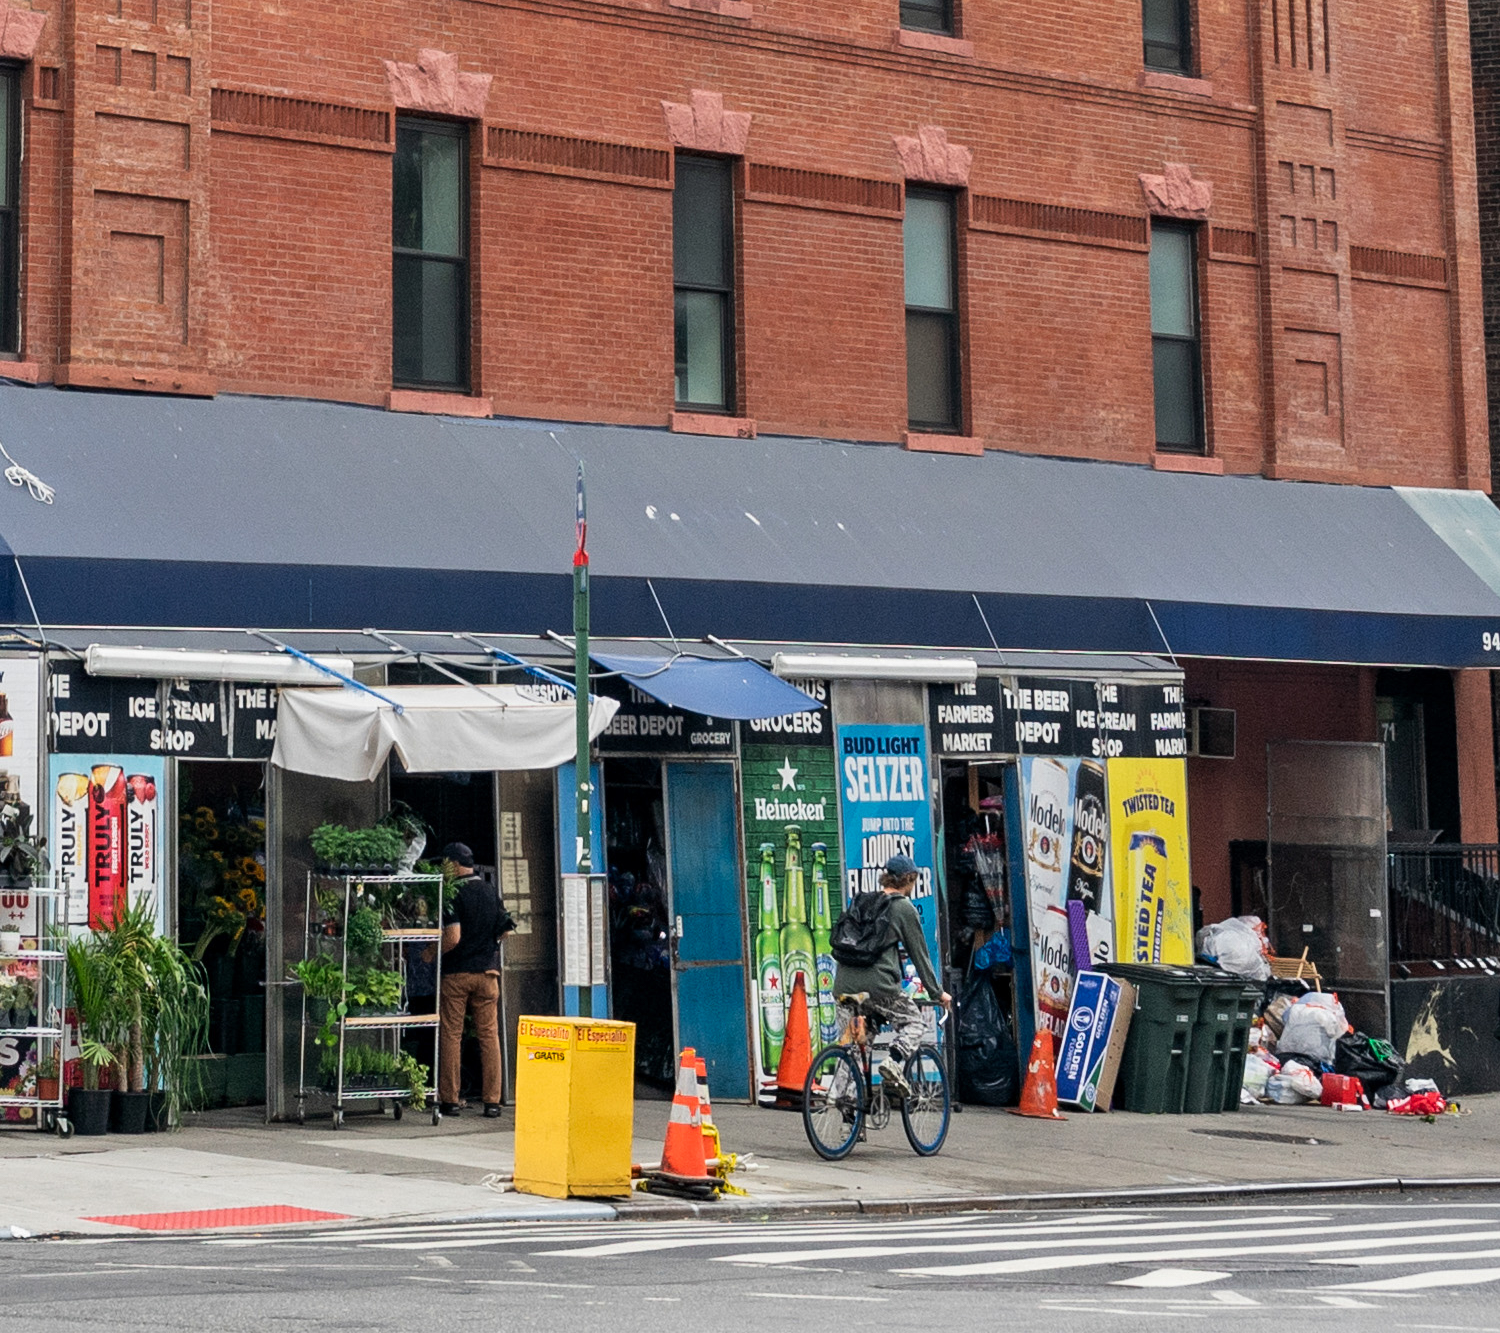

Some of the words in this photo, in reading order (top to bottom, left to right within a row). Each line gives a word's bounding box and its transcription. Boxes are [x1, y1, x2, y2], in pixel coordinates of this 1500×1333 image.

[236, 689, 267, 709] THE
[954, 683, 976, 696] THE
[1004, 688, 1032, 710] THE
[1035, 689, 1069, 712] BEER
[129, 697, 155, 719] ICE
[938, 706, 994, 724] FARMERS
[604, 715, 637, 735] BEER
[640, 715, 684, 736] DEPOT
[750, 712, 823, 734] GROCERS
[1076, 710, 1094, 729] ICE
[1097, 712, 1136, 731] CREAM
[150, 730, 195, 751] SHOP
[691, 732, 731, 745] GROCERY
[942, 733, 992, 752] MARKET
[1016, 722, 1060, 744] DEPOT
[1381, 722, 1395, 742] 71
[844, 737, 875, 754] BUD
[878, 737, 920, 755] LIGHT
[1092, 738, 1123, 757] SHOP
[844, 756, 925, 802] SELTZER
[754, 797, 825, 821] Heineken
[1031, 794, 1065, 837] Modelo
[1122, 794, 1158, 818] TWISTED
[1160, 797, 1175, 818] TEA
[862, 818, 882, 832] JUMP
[883, 818, 900, 832] INTO
[901, 817, 914, 831] THE
[62, 808, 76, 883] TRULY
[95, 802, 110, 887] TRULY
[131, 809, 143, 883] TRULY
[1142, 863, 1157, 904] TEA
[521, 1023, 527, 1035] El
[530, 1024, 569, 1040] Especialito
[578, 1028, 584, 1041] El
[587, 1028, 627, 1044] Especialito
[534, 1051, 565, 1061] GRATIS
[1064, 1037, 1077, 1072] FLOWERS
[1068, 1032, 1087, 1080] GOLDEN
